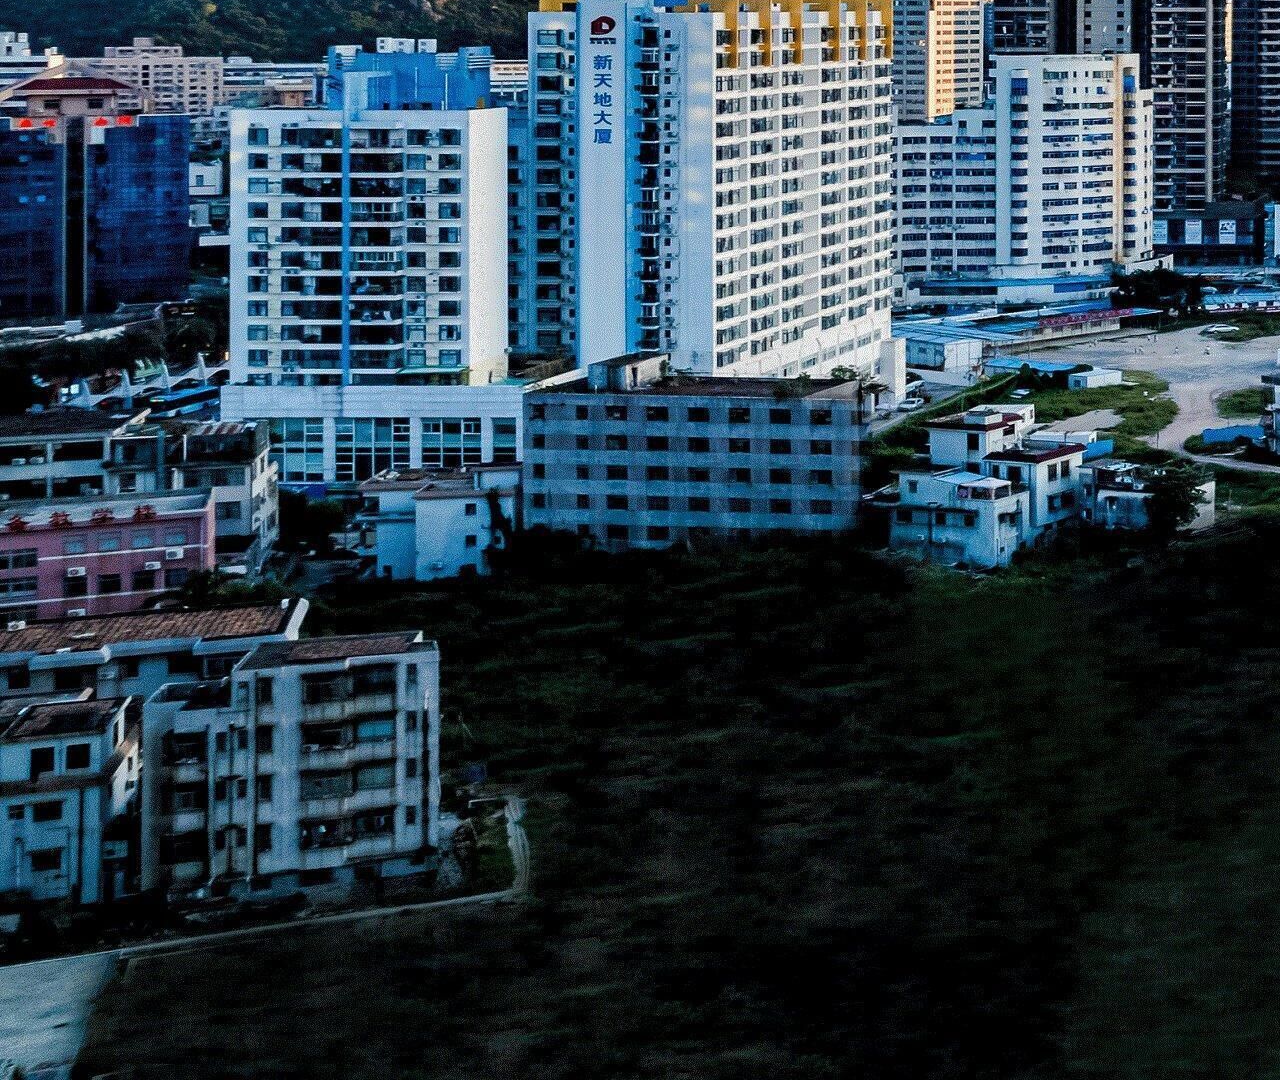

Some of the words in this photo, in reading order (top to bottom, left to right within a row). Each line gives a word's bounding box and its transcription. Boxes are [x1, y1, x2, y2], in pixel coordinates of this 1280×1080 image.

[593, 54, 613, 144] 新天地大厦
